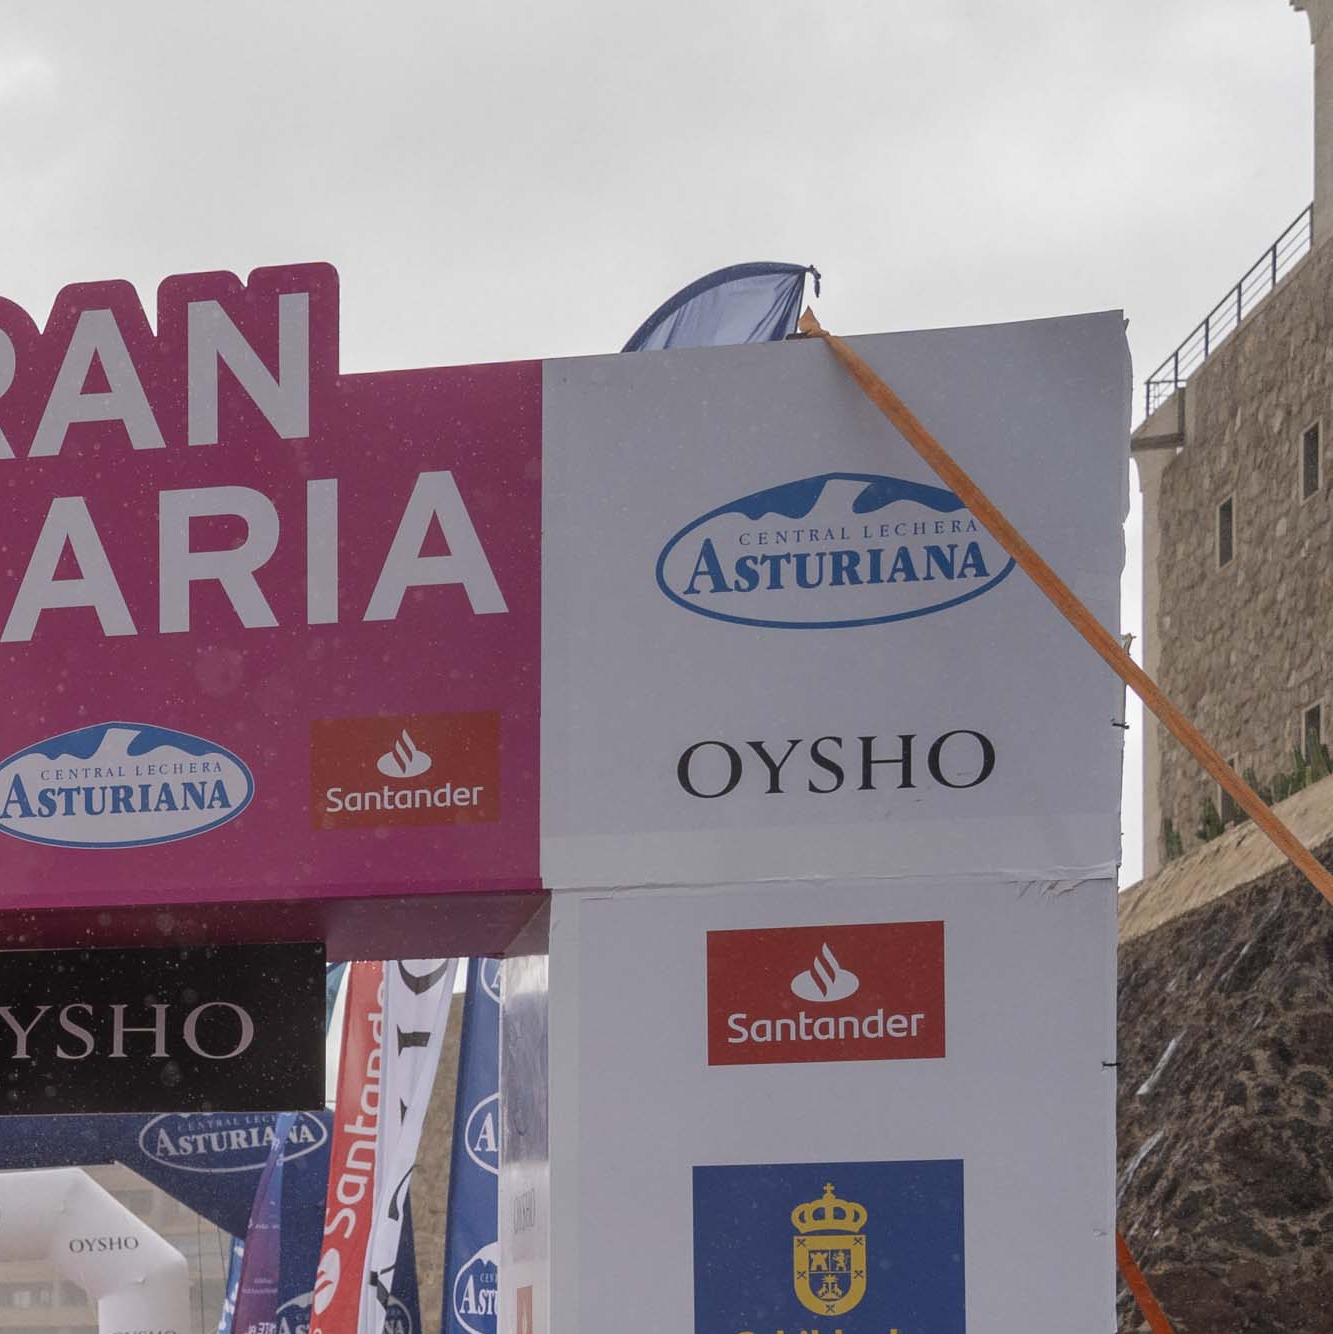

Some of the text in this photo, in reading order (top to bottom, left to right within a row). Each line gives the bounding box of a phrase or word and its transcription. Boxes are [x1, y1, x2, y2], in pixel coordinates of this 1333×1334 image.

[739, 518, 979, 547] CENTRAL LECHERA
[683, 539, 990, 596] ASTURIANA
[41, 760, 223, 783] CENTRAL LECHERA
[677, 730, 996, 798] OYSHO
[0, 770, 232, 820] ASTURIANA
[326, 782, 484, 814] Santander
[728, 1012, 924, 1044] Santander
[69, 1237, 139, 1252] OYSHO
